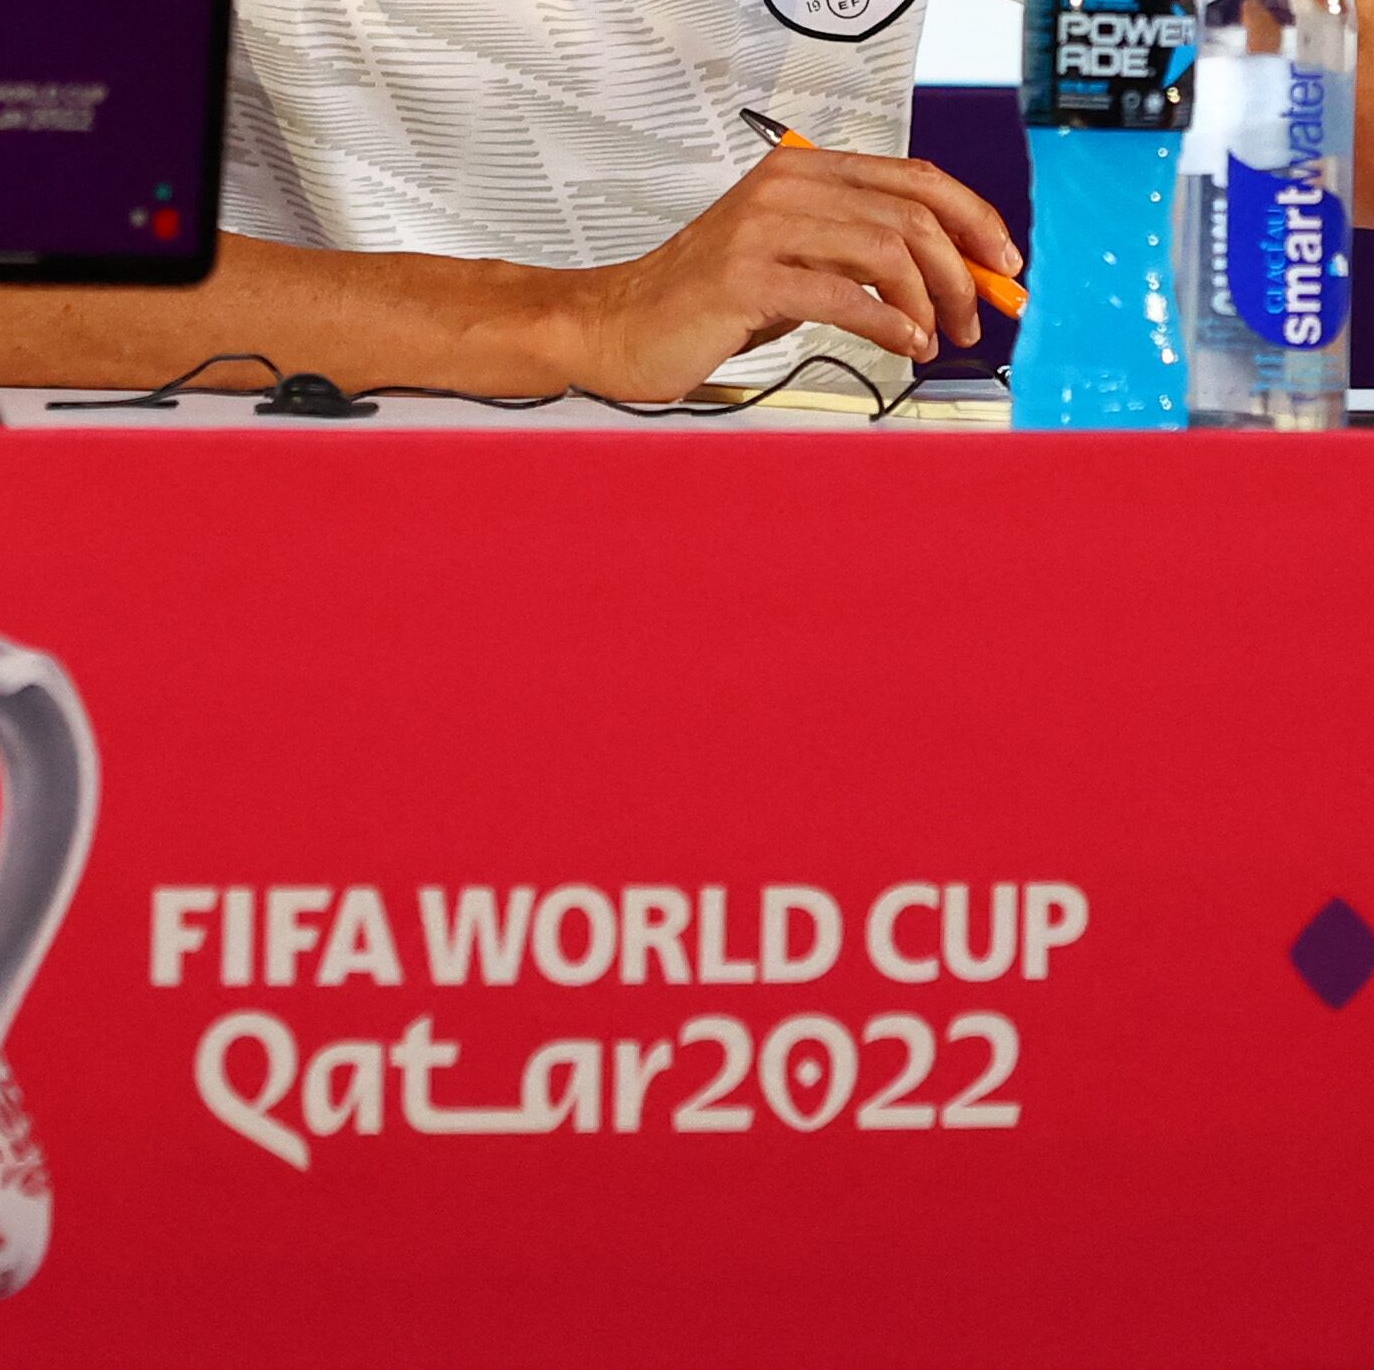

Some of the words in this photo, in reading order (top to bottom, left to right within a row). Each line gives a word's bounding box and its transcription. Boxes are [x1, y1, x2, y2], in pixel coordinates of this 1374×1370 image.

[1057, 13, 1196, 48] POWER
[1057, 43, 1151, 78] ADE
[150, 885, 403, 987] FIFA
[418, 883, 843, 986] WORLD
[866, 881, 1089, 983] CUP
[194, 1010, 1021, 1170] Qatar2022
